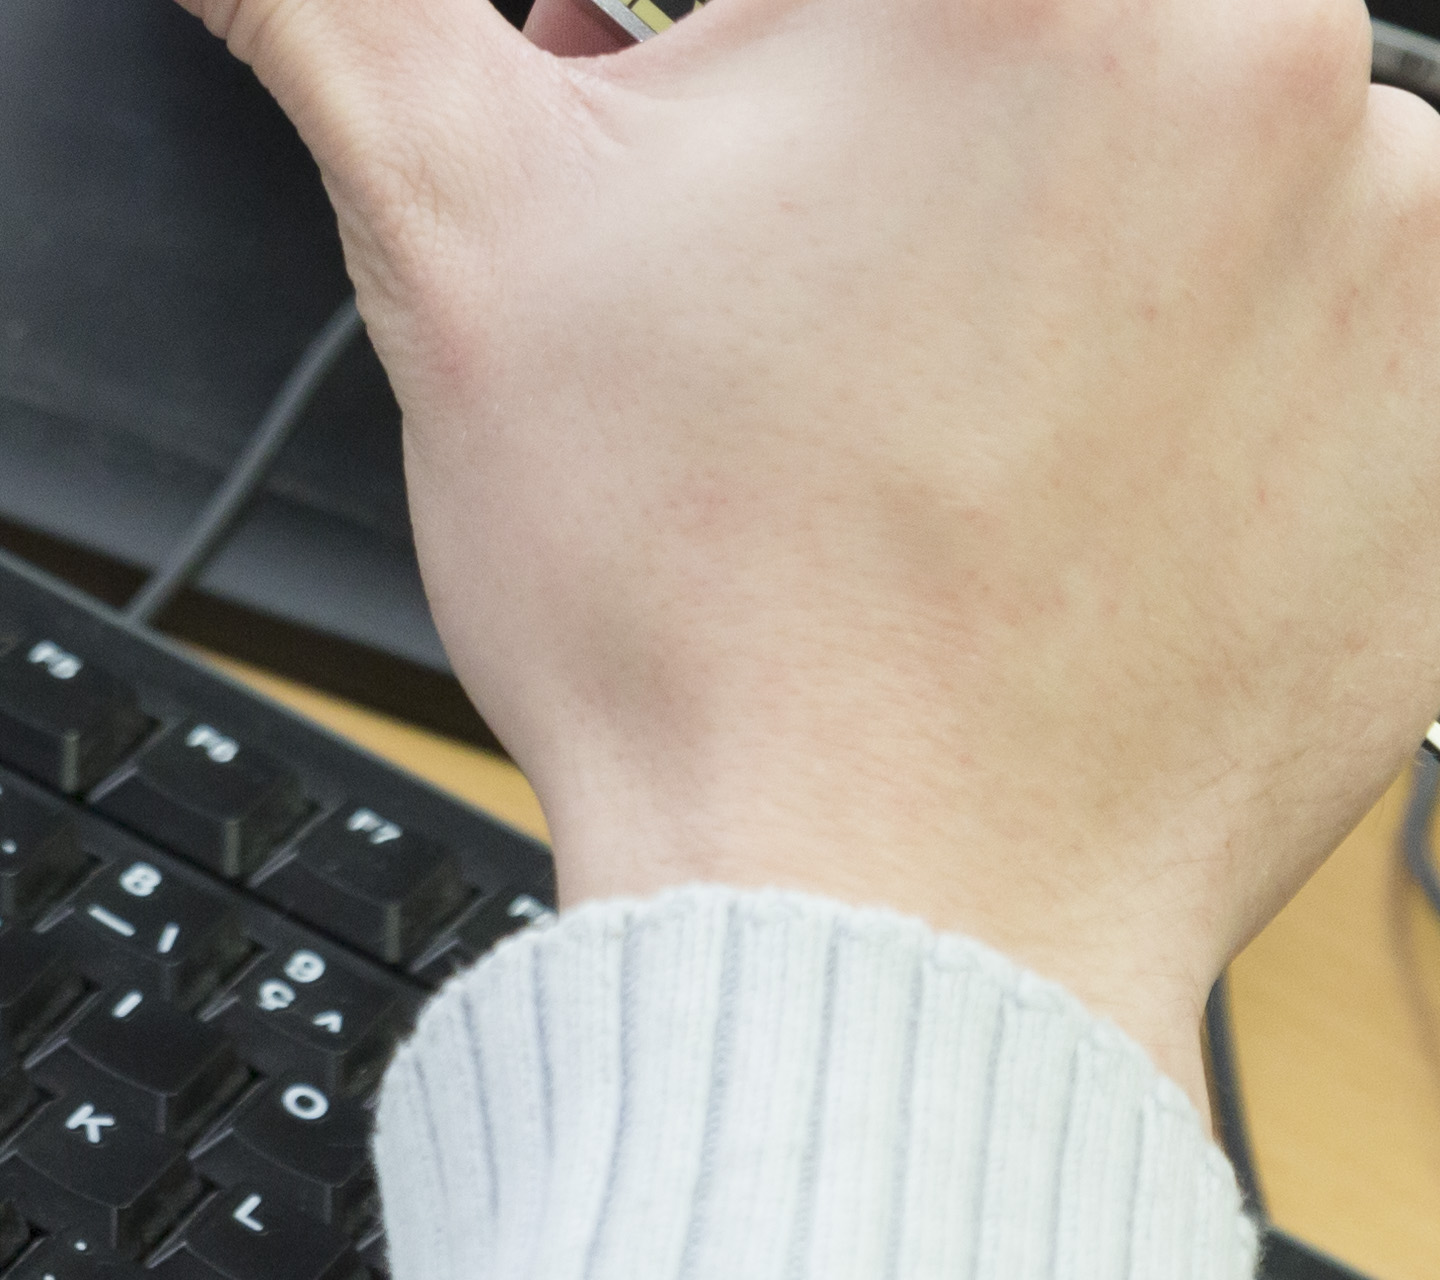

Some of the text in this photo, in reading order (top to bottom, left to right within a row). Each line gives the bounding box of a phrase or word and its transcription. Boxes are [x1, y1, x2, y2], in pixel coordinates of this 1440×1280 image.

[118, 861, 164, 899] 8
[282, 948, 328, 986] 9
[280, 1082, 331, 1122] O
[63, 1102, 117, 1145] K
[231, 1192, 265, 1233] L
